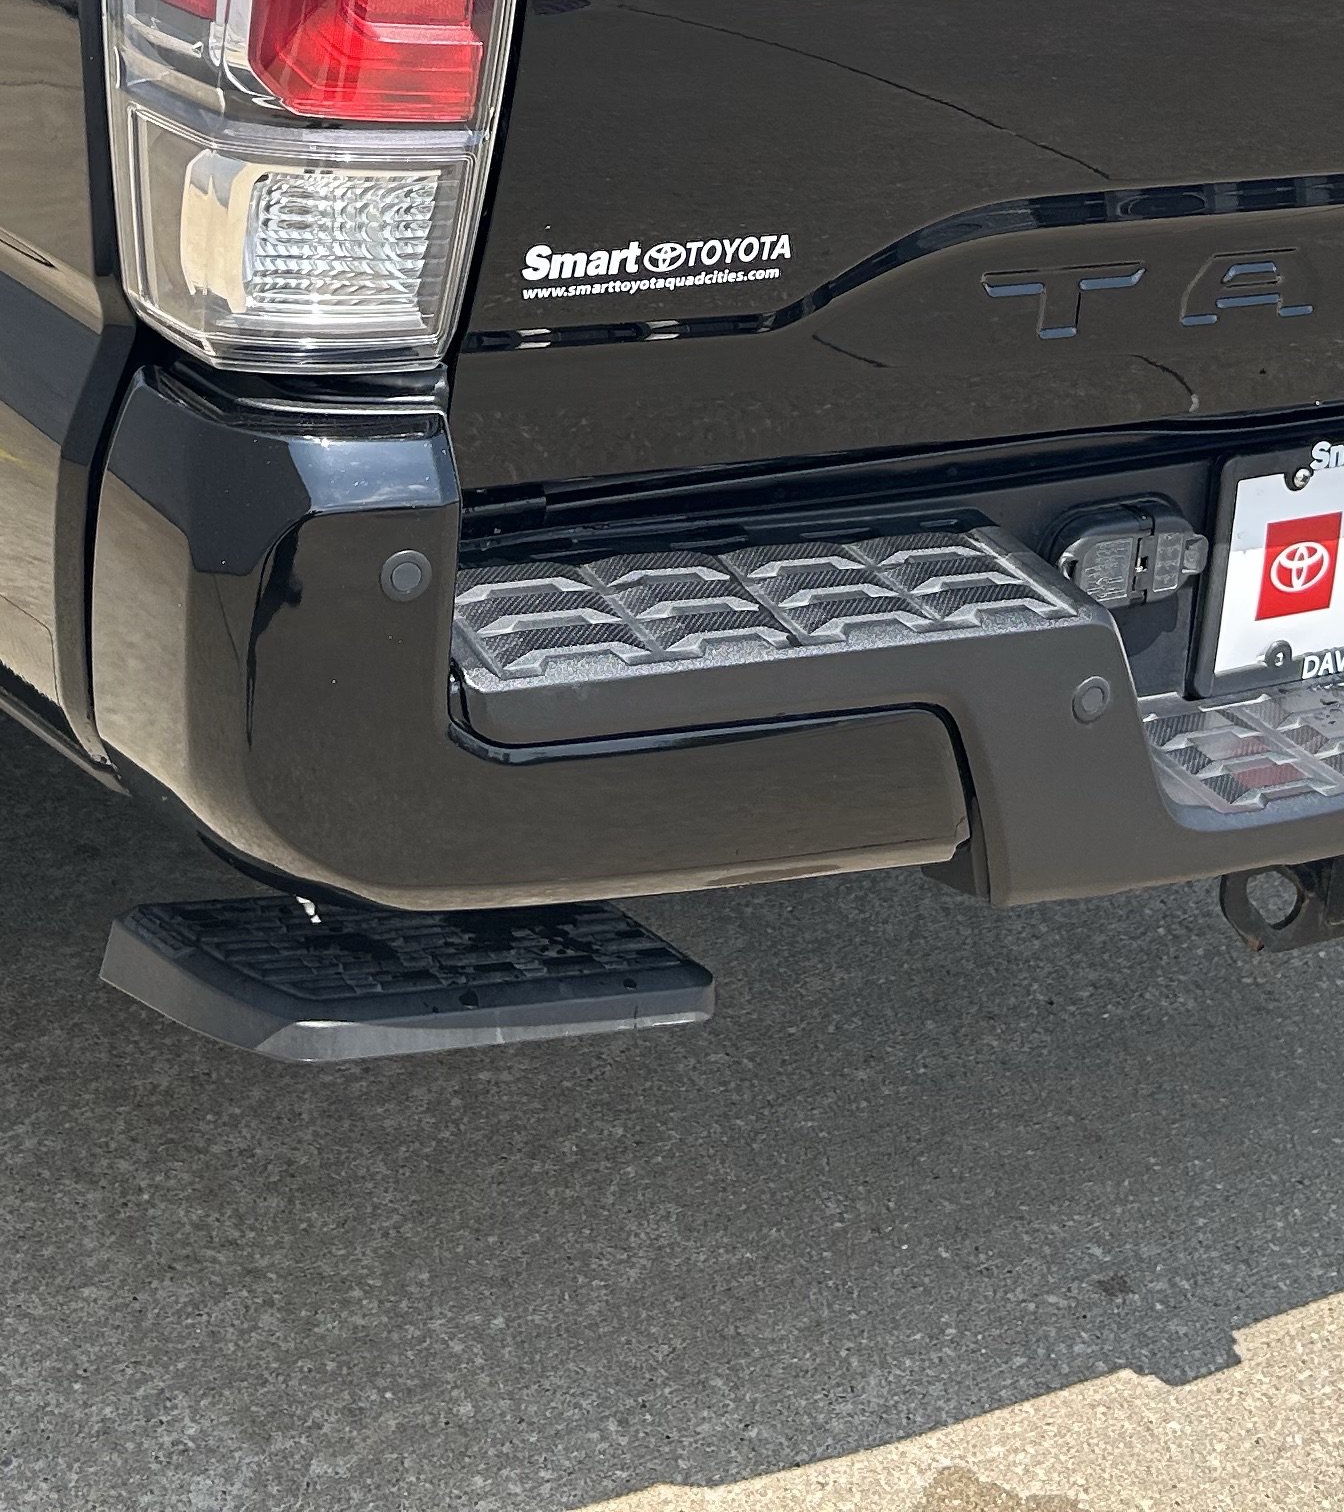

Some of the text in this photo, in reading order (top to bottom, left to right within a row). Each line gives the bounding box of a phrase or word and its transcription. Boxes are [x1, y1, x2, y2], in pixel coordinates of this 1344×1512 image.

[522, 234, 791, 281] Smart TOYOTA
[522, 266, 780, 299] www.smarttoyotaquadcities.com
